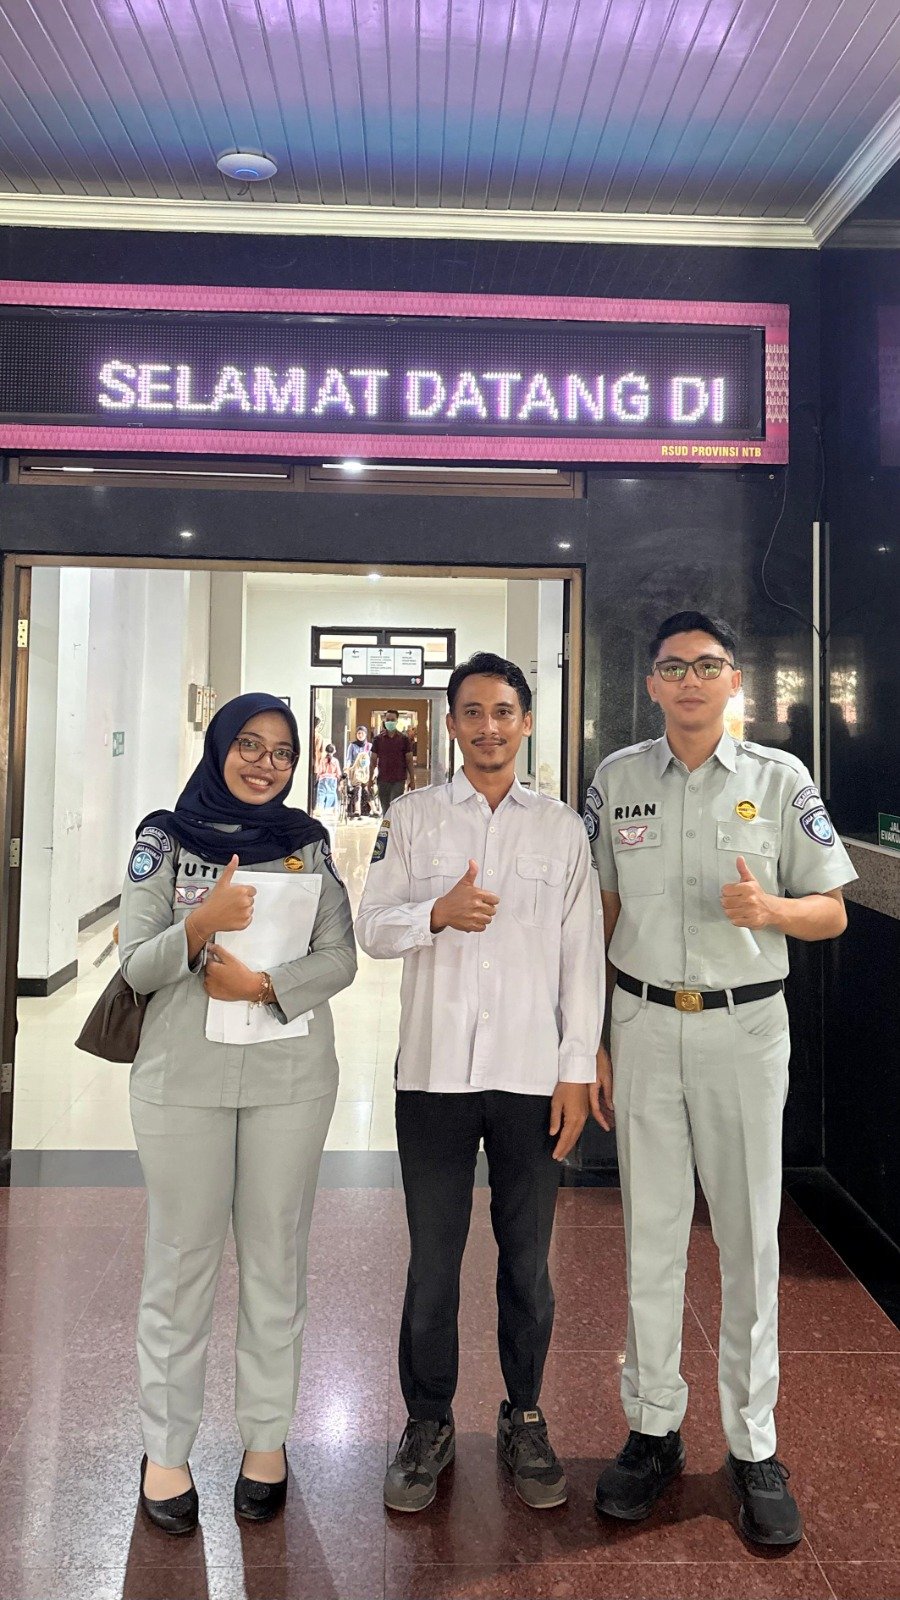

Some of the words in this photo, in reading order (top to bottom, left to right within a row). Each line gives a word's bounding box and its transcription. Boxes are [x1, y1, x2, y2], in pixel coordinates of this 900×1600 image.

[98, 360, 389, 416] SELAMAT
[405, 370, 650, 421] DATANG
[670, 376, 725, 424] DI
[661, 445, 689, 456] RSUD
[691, 446, 739, 457] PROVINSI
[741, 446, 762, 457] NTB
[614, 803, 656, 820] RIAN
